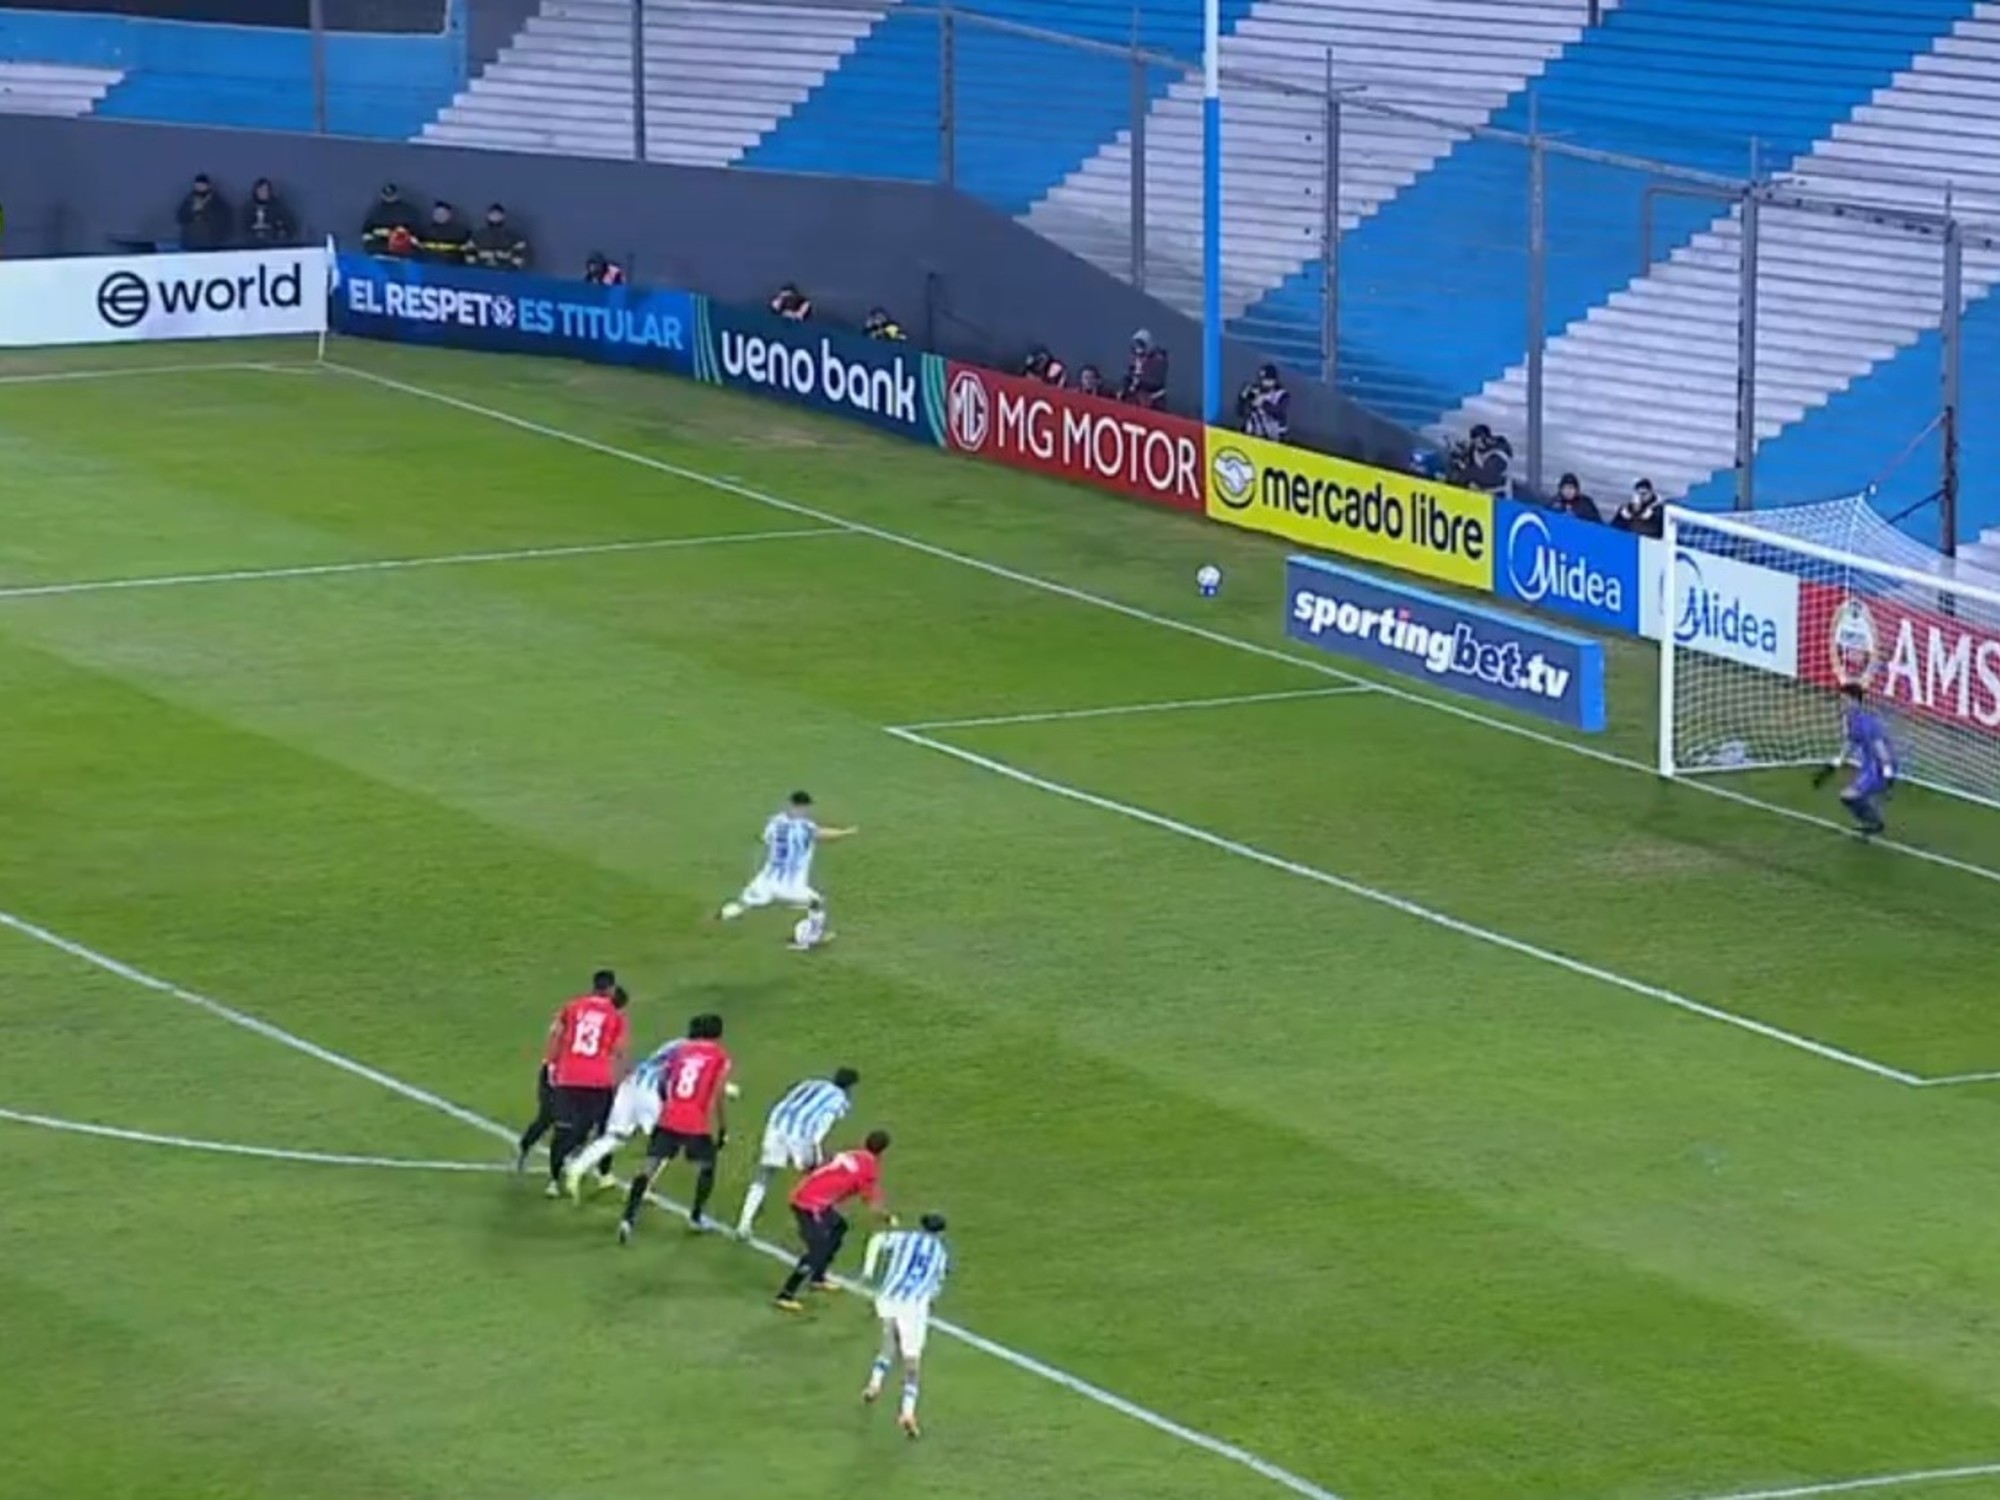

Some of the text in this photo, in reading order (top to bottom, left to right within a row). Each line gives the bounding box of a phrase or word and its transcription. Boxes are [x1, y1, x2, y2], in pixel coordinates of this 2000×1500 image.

[157, 262, 302, 314] world
[349, 278, 382, 313] EL
[519, 297, 554, 334] ES
[557, 303, 684, 351] TITULAR
[721, 329, 917, 423] ueno bank
[998, 391, 1201, 499] MG MOTOR
[1262, 465, 1485, 560] mercado libre
[1514, 532, 1622, 612] Midea
[1293, 590, 1570, 699] sportingbet.tv
[1674, 575, 1778, 654] Midea
[572, 1020, 601, 1057] 13
[675, 1065, 699, 1099] 8
